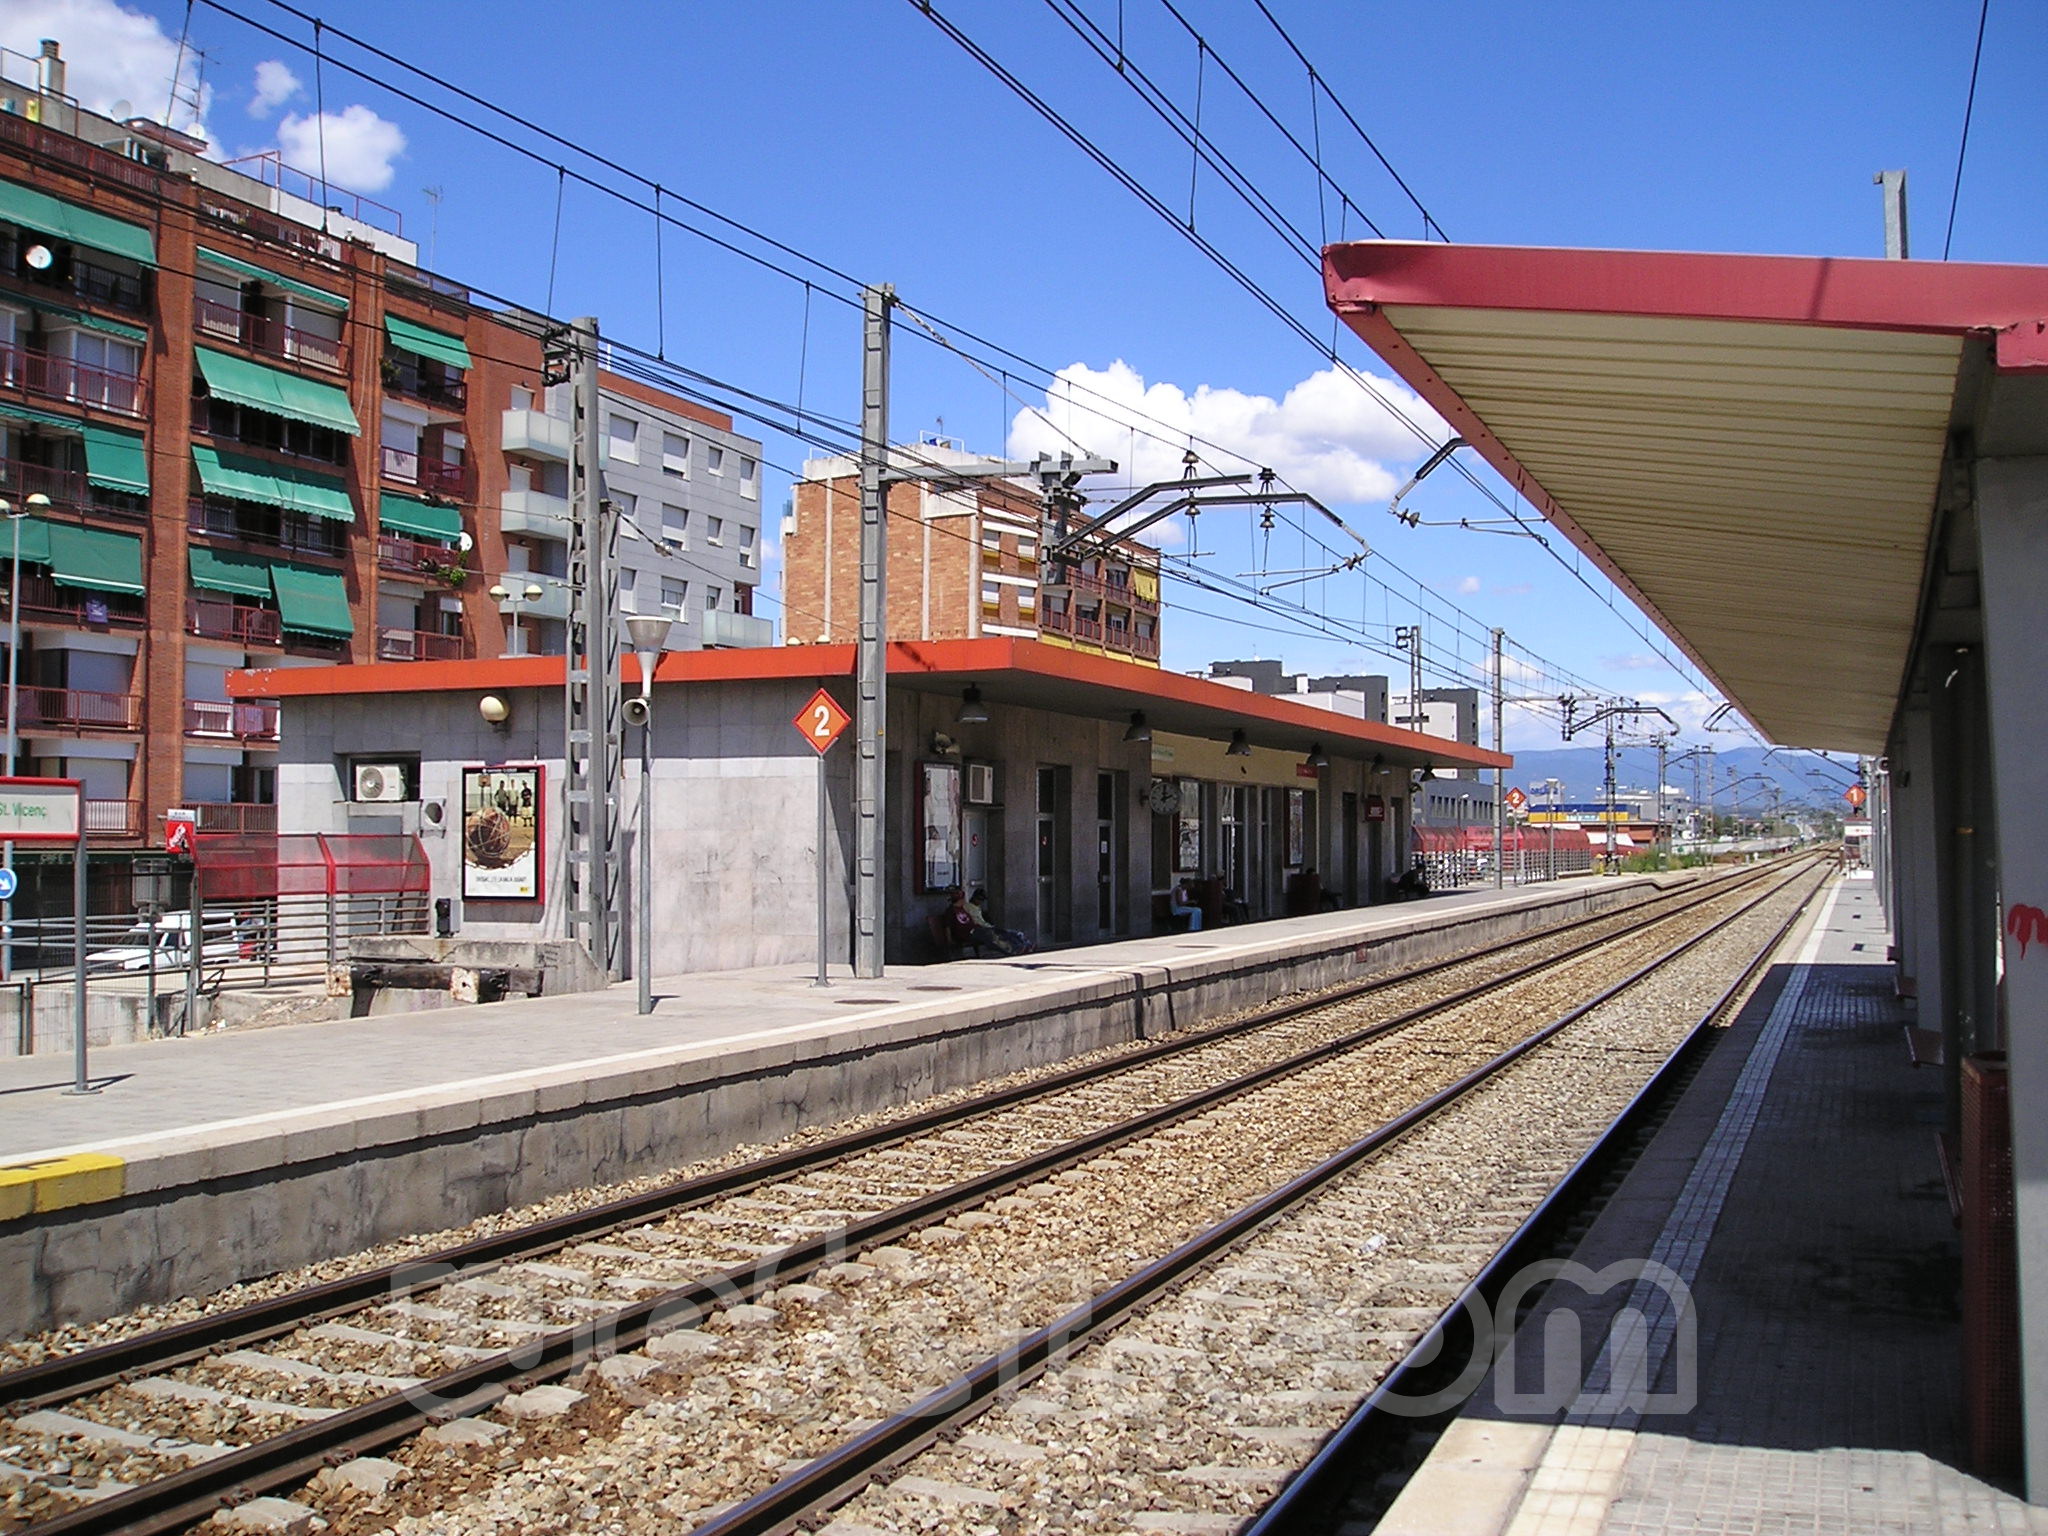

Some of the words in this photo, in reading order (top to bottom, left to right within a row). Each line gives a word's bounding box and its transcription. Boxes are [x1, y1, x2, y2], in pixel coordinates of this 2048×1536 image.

[813, 704, 831, 737] 2
[1512, 792, 1520, 804] 2
[1850, 788, 1858, 802] 1
